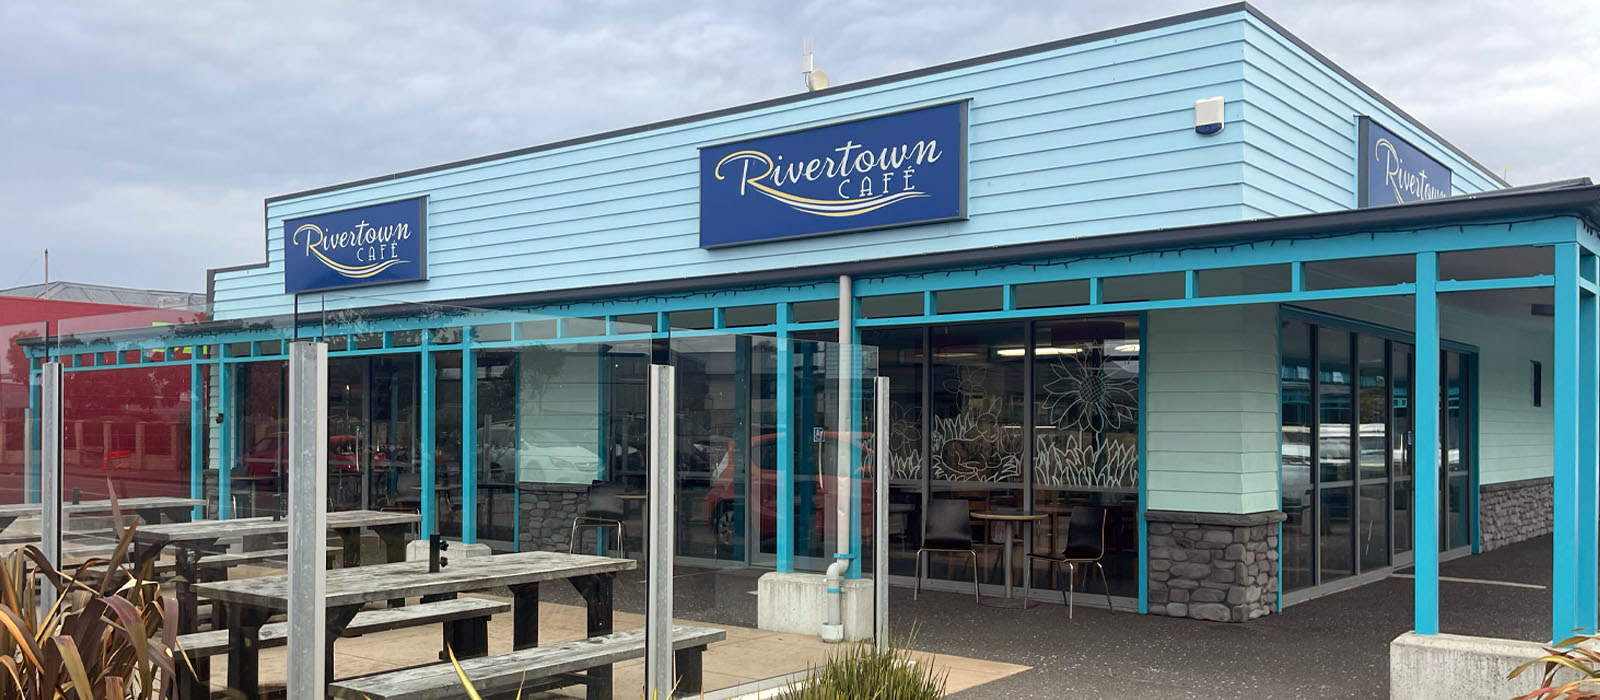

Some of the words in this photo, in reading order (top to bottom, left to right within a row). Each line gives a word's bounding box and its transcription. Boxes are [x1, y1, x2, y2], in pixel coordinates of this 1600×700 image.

[714, 139, 942, 202] Rivertown
[838, 165, 916, 199] CAFÉ
[293, 219, 412, 261] Rivertown
[356, 239, 399, 262] CAFÉ
